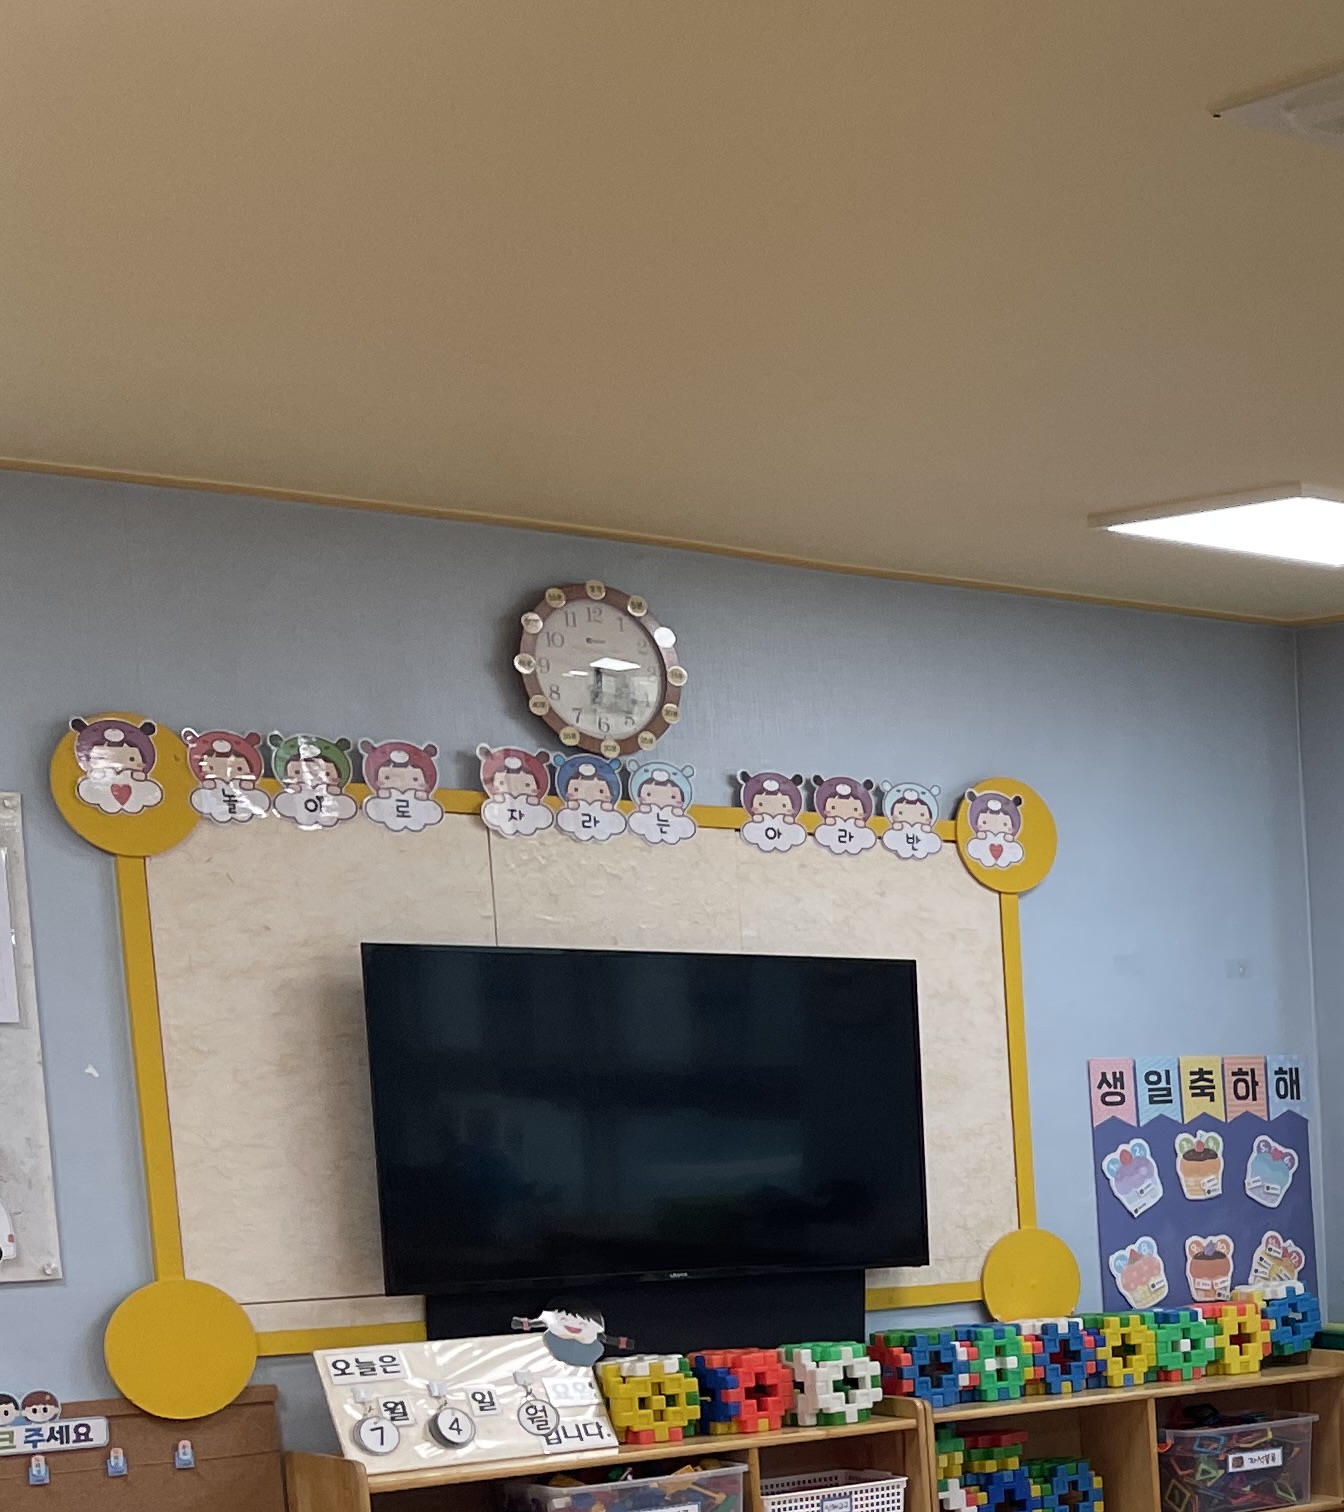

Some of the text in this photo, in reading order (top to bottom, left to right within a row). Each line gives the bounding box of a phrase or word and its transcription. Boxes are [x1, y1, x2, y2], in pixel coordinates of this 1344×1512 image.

[220, 789, 922, 852] 놀이로 자라는 아라반
[331, 1354, 401, 1377] 오늘은
[23, 1422, 94, 1450] 주세요
[369, 1425, 386, 1447] 7
[382, 1399, 411, 1422] 월
[448, 1416, 463, 1436] 4
[470, 1389, 498, 1413] 일
